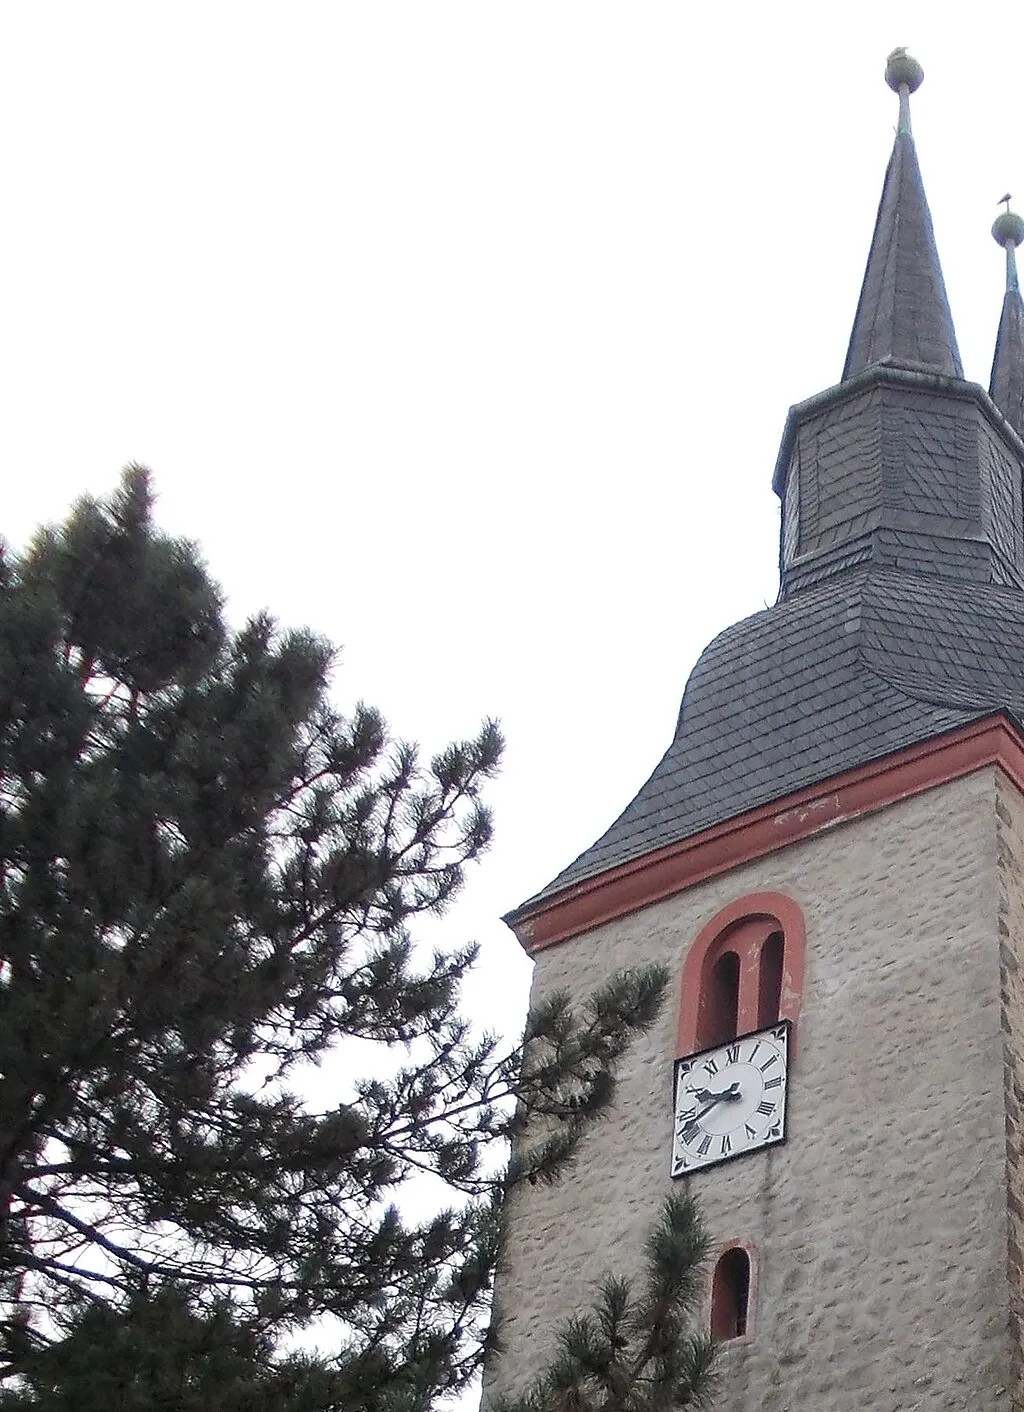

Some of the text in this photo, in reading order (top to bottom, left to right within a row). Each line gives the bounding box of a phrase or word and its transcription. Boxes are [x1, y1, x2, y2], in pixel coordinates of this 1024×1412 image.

[725, 1045, 741, 1067] XII
[748, 1044, 760, 1063] I
[703, 1058, 719, 1079] XI
[760, 1055, 778, 1073] II
[764, 1075, 782, 1090] III
[680, 1105, 696, 1122] IX
[745, 1123, 757, 1140] V
[696, 1135, 713, 1155] VII
[721, 1135, 732, 1154] VI
